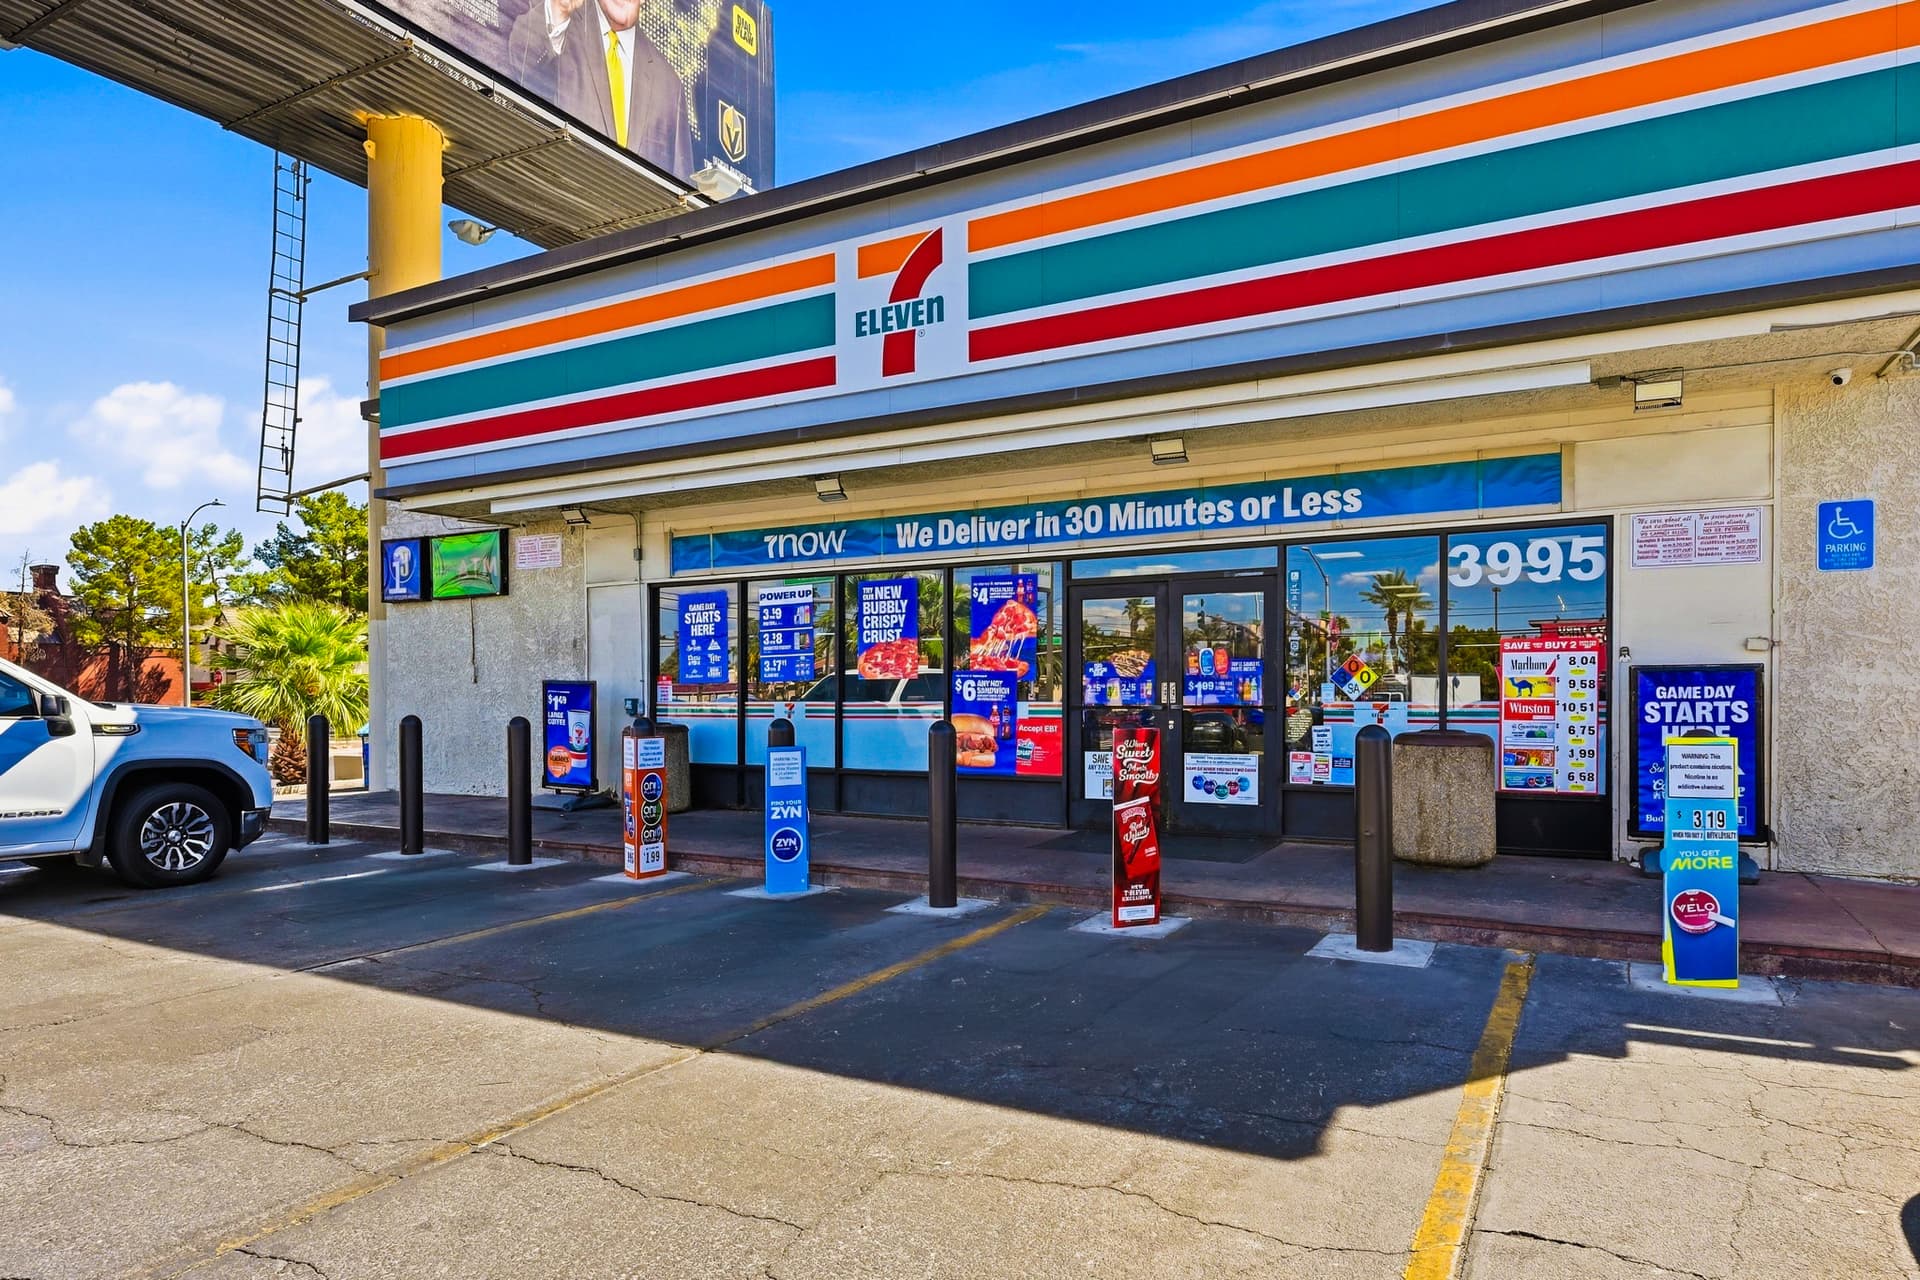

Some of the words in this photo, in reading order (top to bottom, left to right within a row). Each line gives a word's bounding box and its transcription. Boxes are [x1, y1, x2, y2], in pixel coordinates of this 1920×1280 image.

[883, 227, 943, 378] 7
[856, 295, 944, 338] ELEVEn
[896, 521, 932, 551] We
[937, 516, 1032, 547] Deliver
[1035, 511, 1060, 539] in
[1065, 505, 1104, 537] 30
[1109, 498, 1234, 533] Minutes
[1239, 492, 1276, 522] or
[1282, 486, 1362, 519] Less
[1825, 542, 1867, 553] PARKING
[1447, 536, 1606, 588] 3995
[760, 591, 796, 601] POWER
[798, 589, 811, 598] UP
[875, 585, 902, 600] NEW
[863, 599, 908, 615] BUBBLY
[684, 611, 721, 624] STARTS
[763, 608, 770, 620] 3
[863, 614, 906, 630] CRISPY
[691, 624, 715, 636] HERE
[863, 629, 902, 643] CRUST
[763, 633, 770, 645] 3
[1503, 641, 1531, 650] SAVE
[1545, 641, 1568, 650] BUY
[1570, 641, 1577, 649] 2
[1511, 655, 1549, 671] Marlboro
[1569, 656, 1596, 668] 8.04
[955, 677, 976, 702] $6
[1348, 683, 1360, 695] SA
[1569, 679, 1596, 691] 9.58
[1656, 686, 1702, 699] GAME
[1704, 685, 1737, 699] DAY
[1510, 702, 1550, 714] Winston
[1562, 702, 1594, 715] 10.51
[1644, 700, 1749, 724] STARTS
[1018, 724, 1043, 734] Accept
[1044, 725, 1057, 733] EBT
[1568, 725, 1595, 738] 6.75
[1092, 753, 1109, 764] SAVE
[1116, 744, 1154, 762] Sweet
[1118, 768, 1159, 784] Smooth
[1567, 771, 1594, 784] 6.58
[770, 805, 802, 819] ZYN
[1693, 810, 1725, 829] 3.19
[775, 837, 797, 848] ZYN
[1701, 849, 1721, 857] GET
[1670, 856, 1734, 871] MORE
[1676, 902, 1715, 913] VELO
